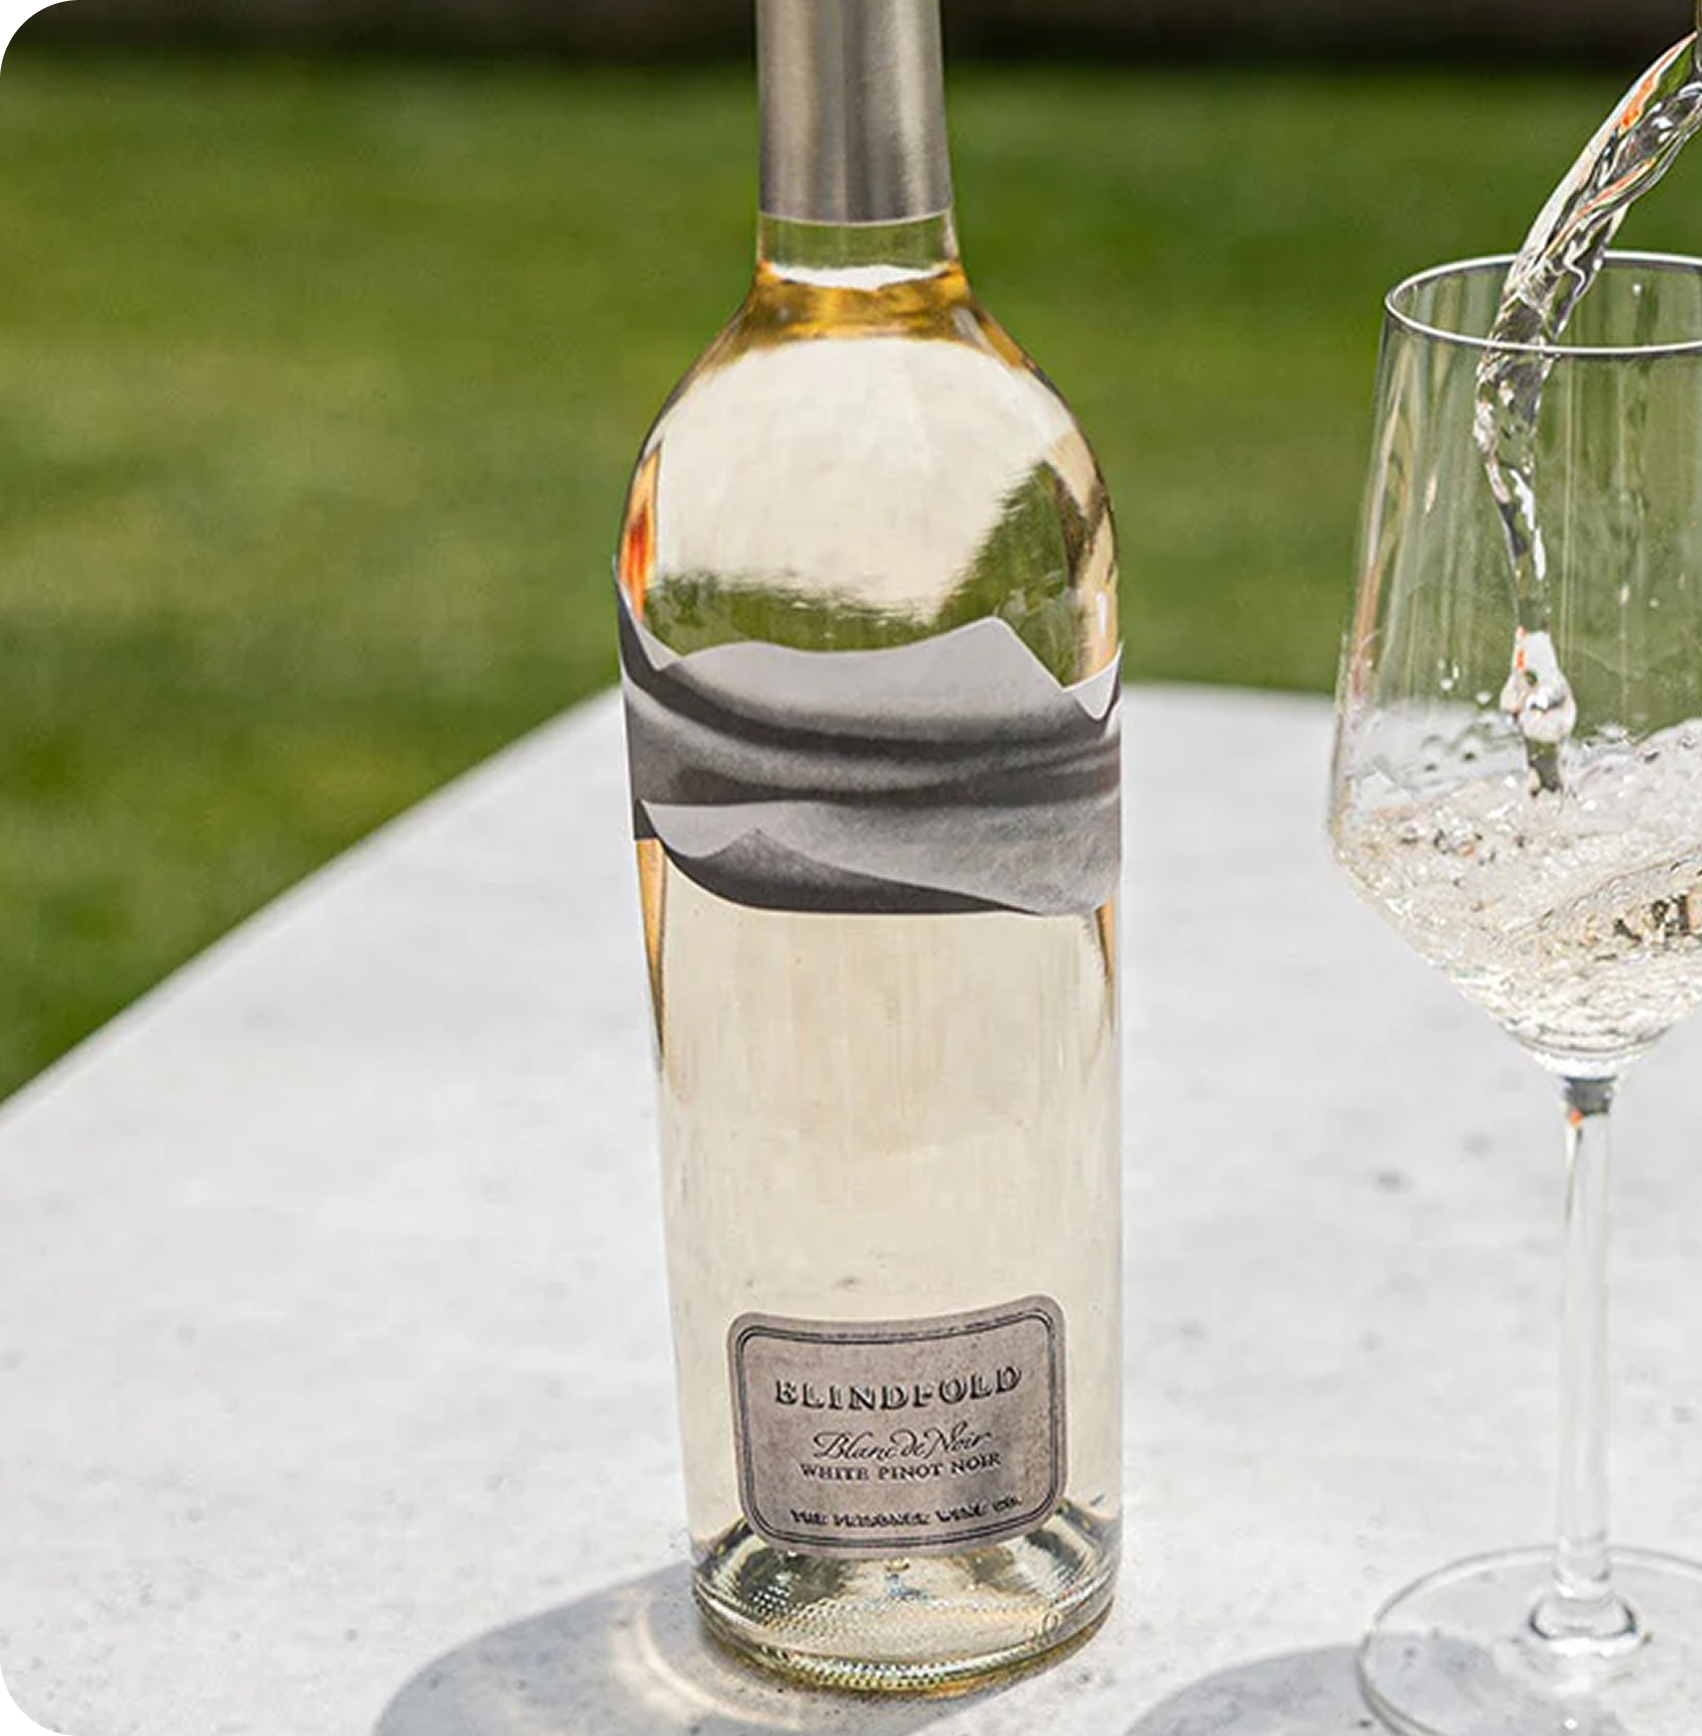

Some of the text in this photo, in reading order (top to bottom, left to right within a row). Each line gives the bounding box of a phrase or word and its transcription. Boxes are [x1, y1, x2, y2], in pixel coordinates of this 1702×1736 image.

[774, 1365, 1022, 1411] BLINDFOLD
[812, 1420, 992, 1461] Blanc de Noir
[799, 1451, 1002, 1481] WHITE PINOT NOIR
